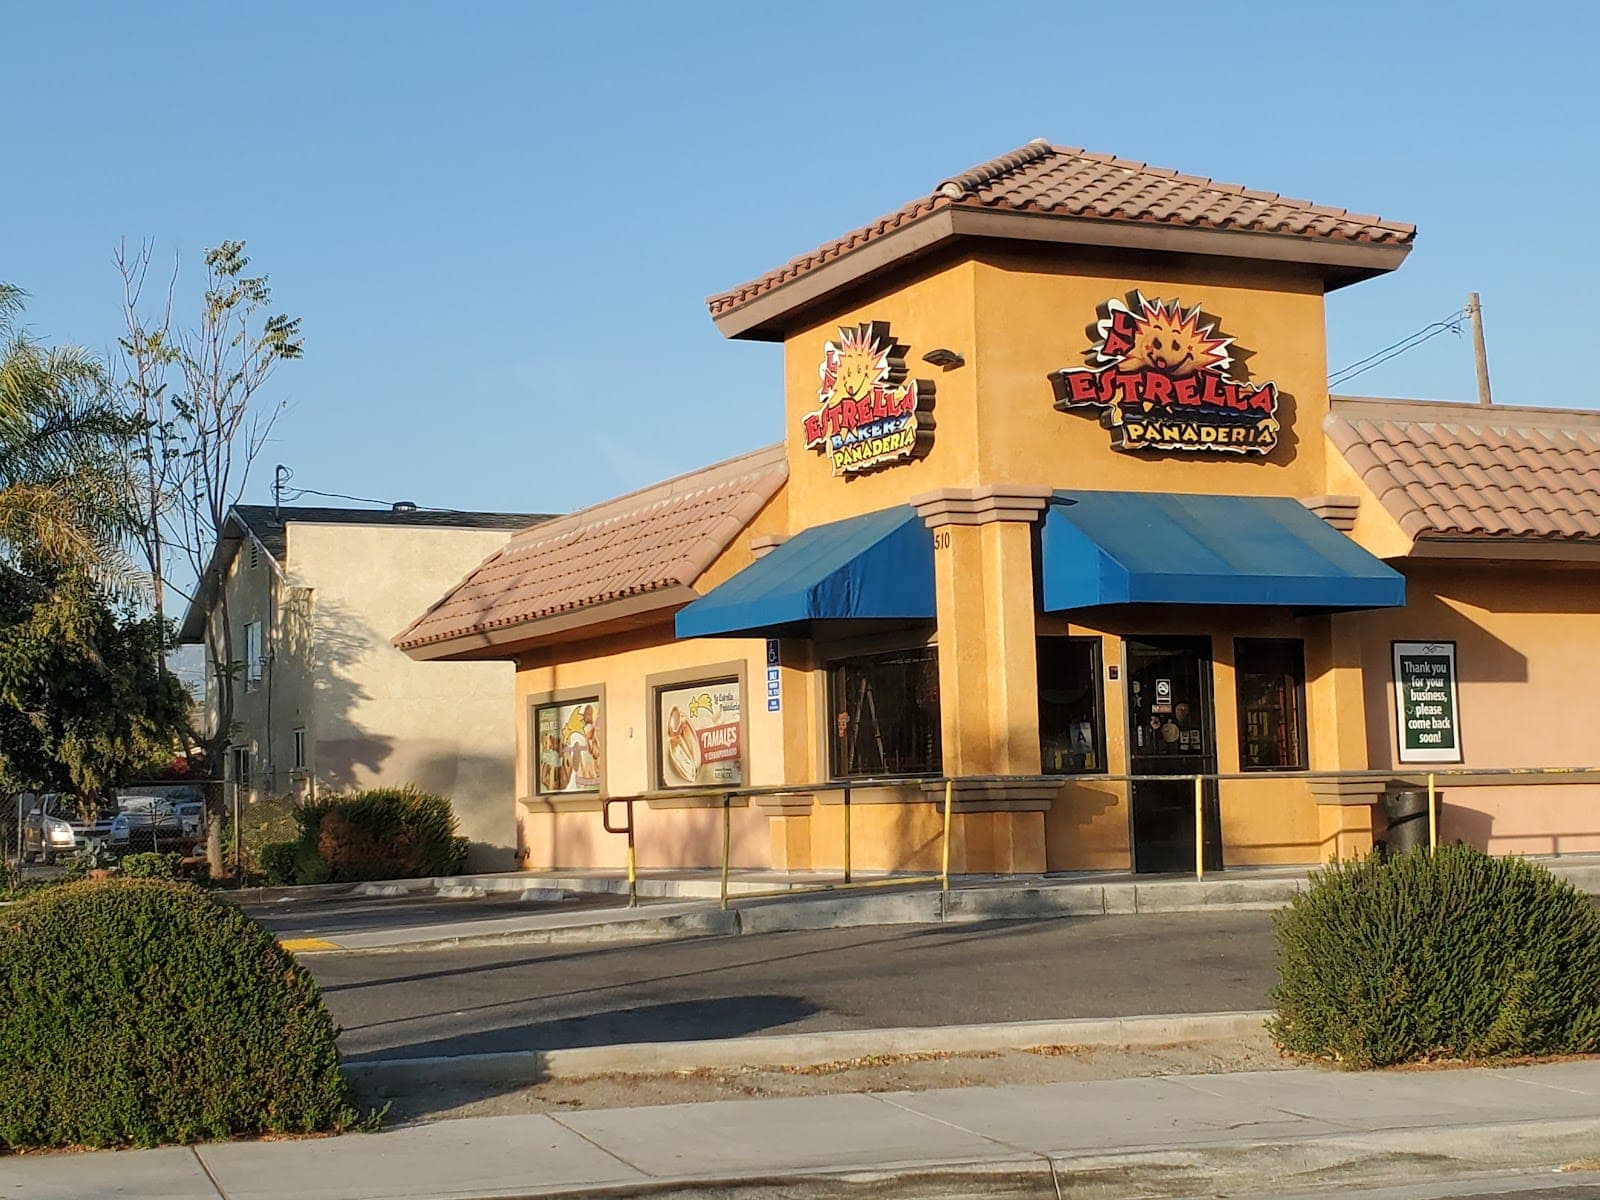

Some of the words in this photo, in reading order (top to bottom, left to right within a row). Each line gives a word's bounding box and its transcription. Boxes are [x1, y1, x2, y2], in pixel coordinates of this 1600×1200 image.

[1103, 312, 1133, 355] LA
[821, 351, 838, 395] LA
[1068, 371, 1273, 413] ESTRELLA
[804, 384, 915, 443] ESTRELLA
[831, 414, 912, 449] BAKERY
[1126, 423, 1274, 443] PANADERIA
[834, 427, 915, 468] PANADERIA
[934, 532, 950, 550] 510
[1404, 661, 1431, 673] Thank
[1432, 664, 1447, 676] you
[1410, 675, 1424, 688] for
[1425, 678, 1444, 691] your
[1410, 689, 1448, 702] business,
[1415, 703, 1443, 718] please
[1408, 719, 1431, 729] come
[1431, 716, 1451, 729] back
[701, 726, 737, 748] TAMALES
[1419, 731, 1441, 744] soon!
